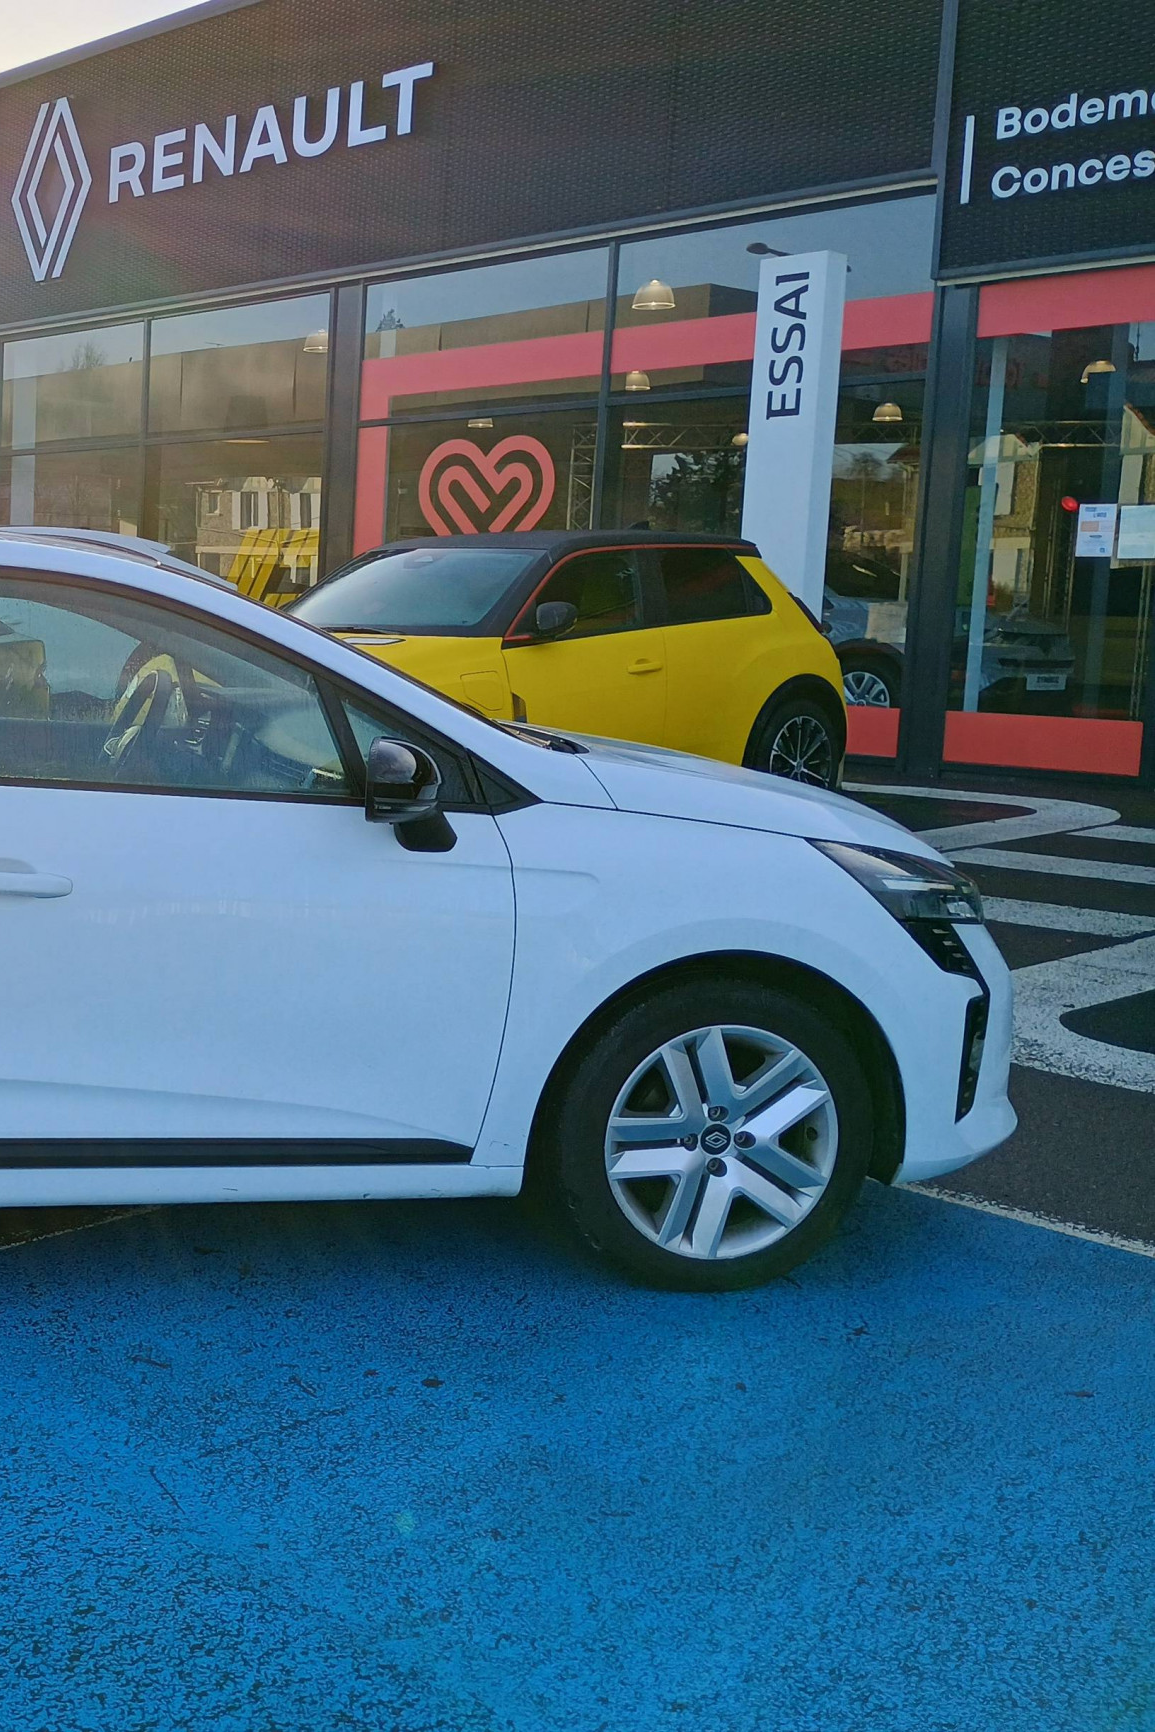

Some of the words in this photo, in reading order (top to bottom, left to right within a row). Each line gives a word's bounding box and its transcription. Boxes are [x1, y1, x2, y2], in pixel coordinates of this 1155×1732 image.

[108, 61, 434, 204] RENAULT
[995, 89, 1155, 140] Bodem
[991, 149, 1155, 199] Conces
[765, 271, 810, 420] ESSAI
